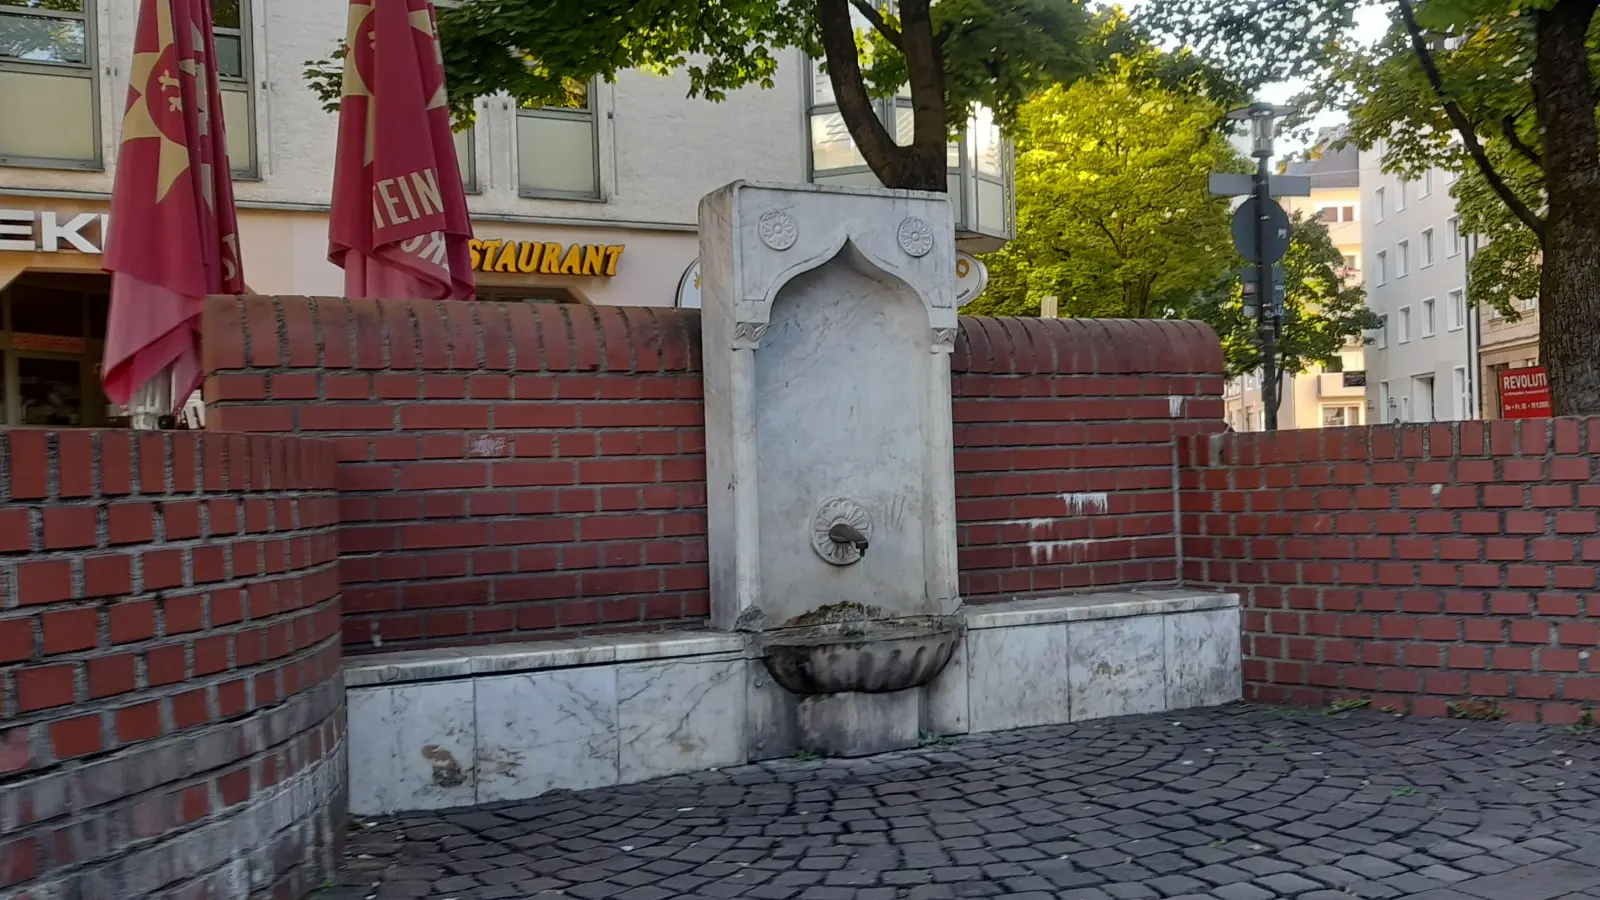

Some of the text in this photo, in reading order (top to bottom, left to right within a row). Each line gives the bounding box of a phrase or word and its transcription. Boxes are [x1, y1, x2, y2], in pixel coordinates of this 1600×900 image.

[0, 209, 110, 254] EK
[468, 238, 625, 276] STAURANT
[1503, 372, 1547, 389] REVOLUTI
